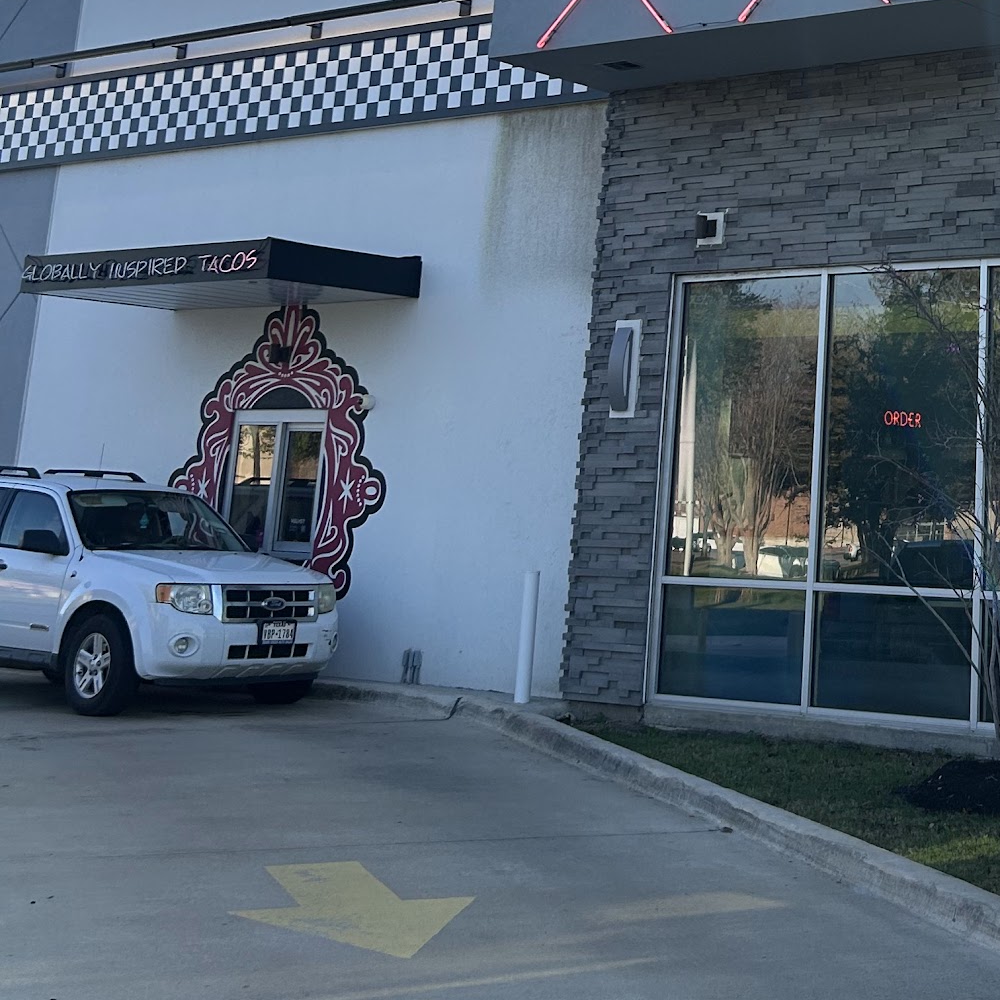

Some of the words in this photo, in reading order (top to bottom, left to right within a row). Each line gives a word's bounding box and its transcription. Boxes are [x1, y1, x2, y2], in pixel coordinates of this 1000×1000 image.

[21, 262, 101, 281] GLOBALLY
[108, 256, 188, 279] INSPIRED
[198, 249, 258, 274] TACOS
[884, 410, 921, 428] ORDER
